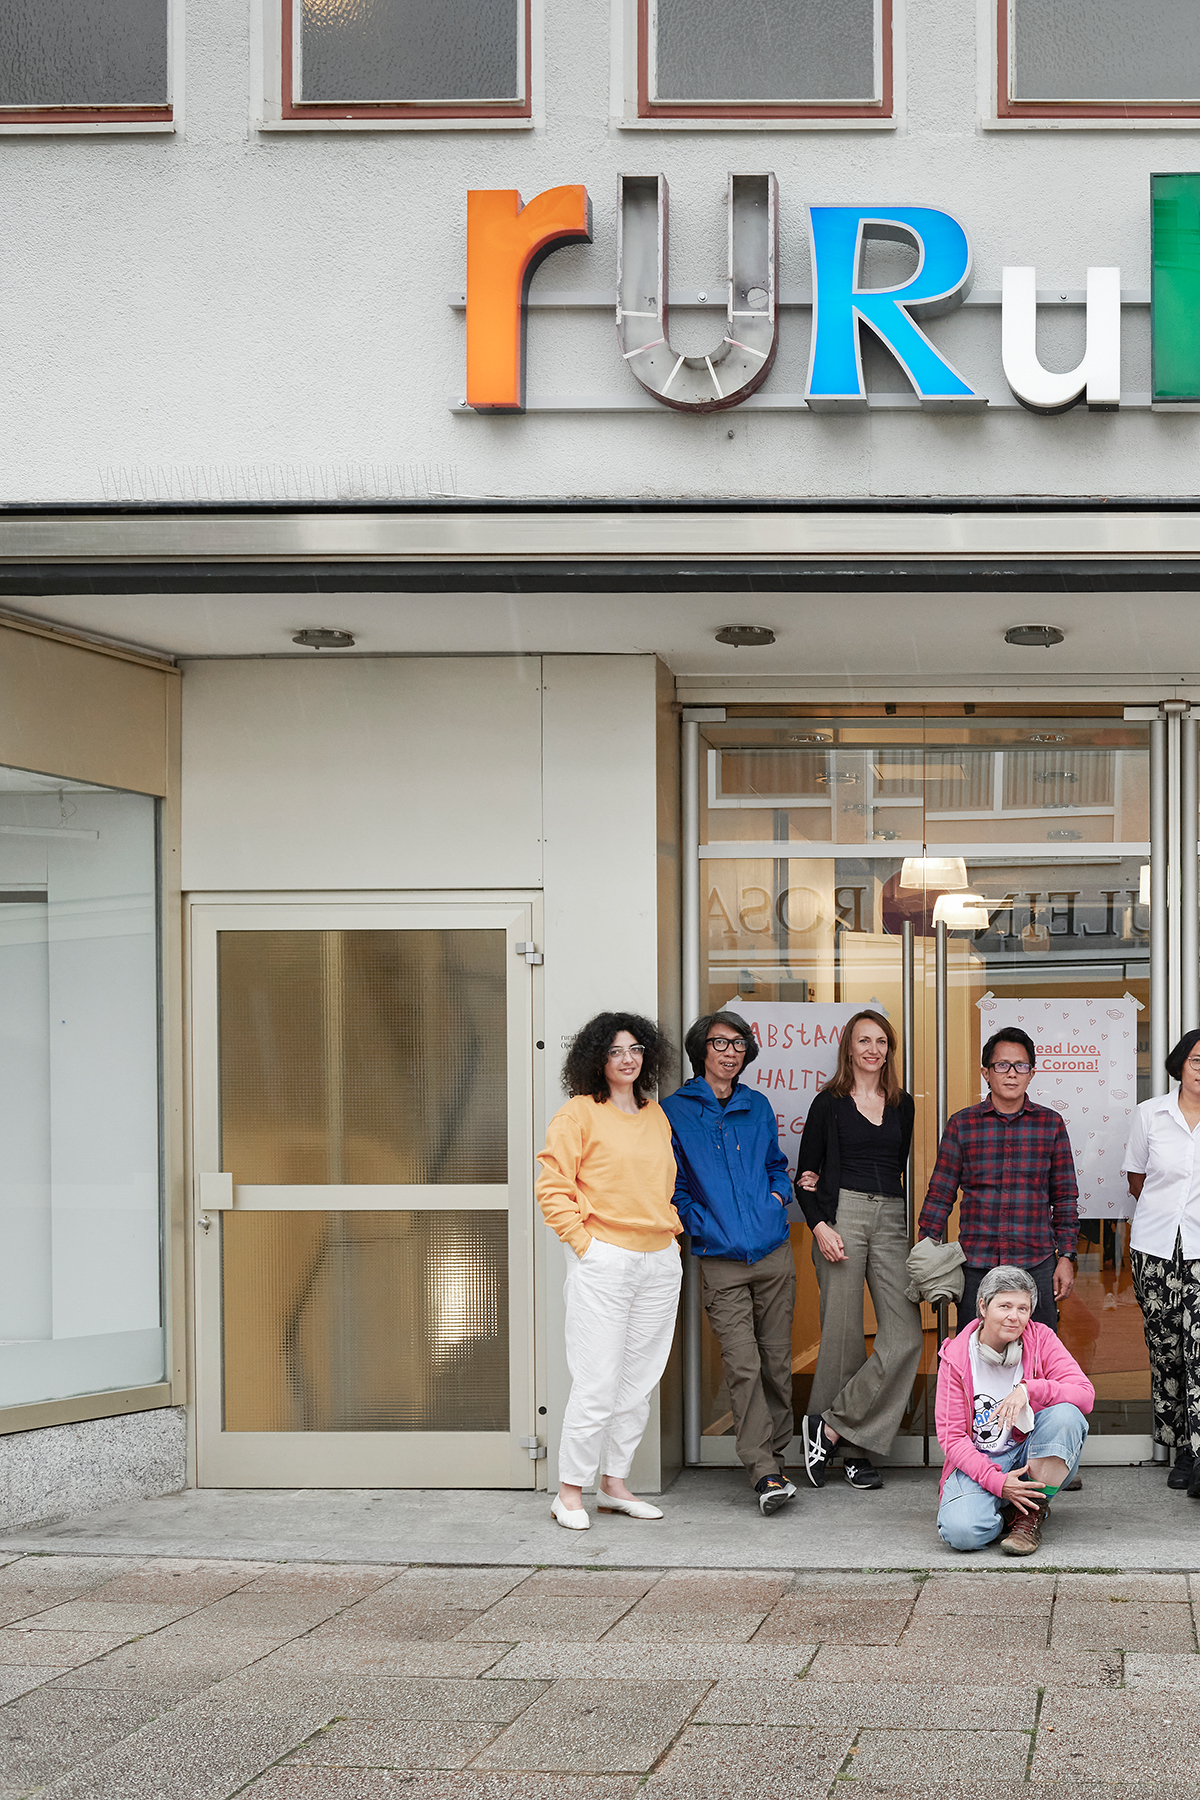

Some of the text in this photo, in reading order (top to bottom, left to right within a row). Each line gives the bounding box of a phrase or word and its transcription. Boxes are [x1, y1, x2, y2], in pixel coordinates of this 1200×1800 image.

[1034, 1042, 1101, 1056] ead love,
[1042, 1059, 1099, 1070] Corona!
